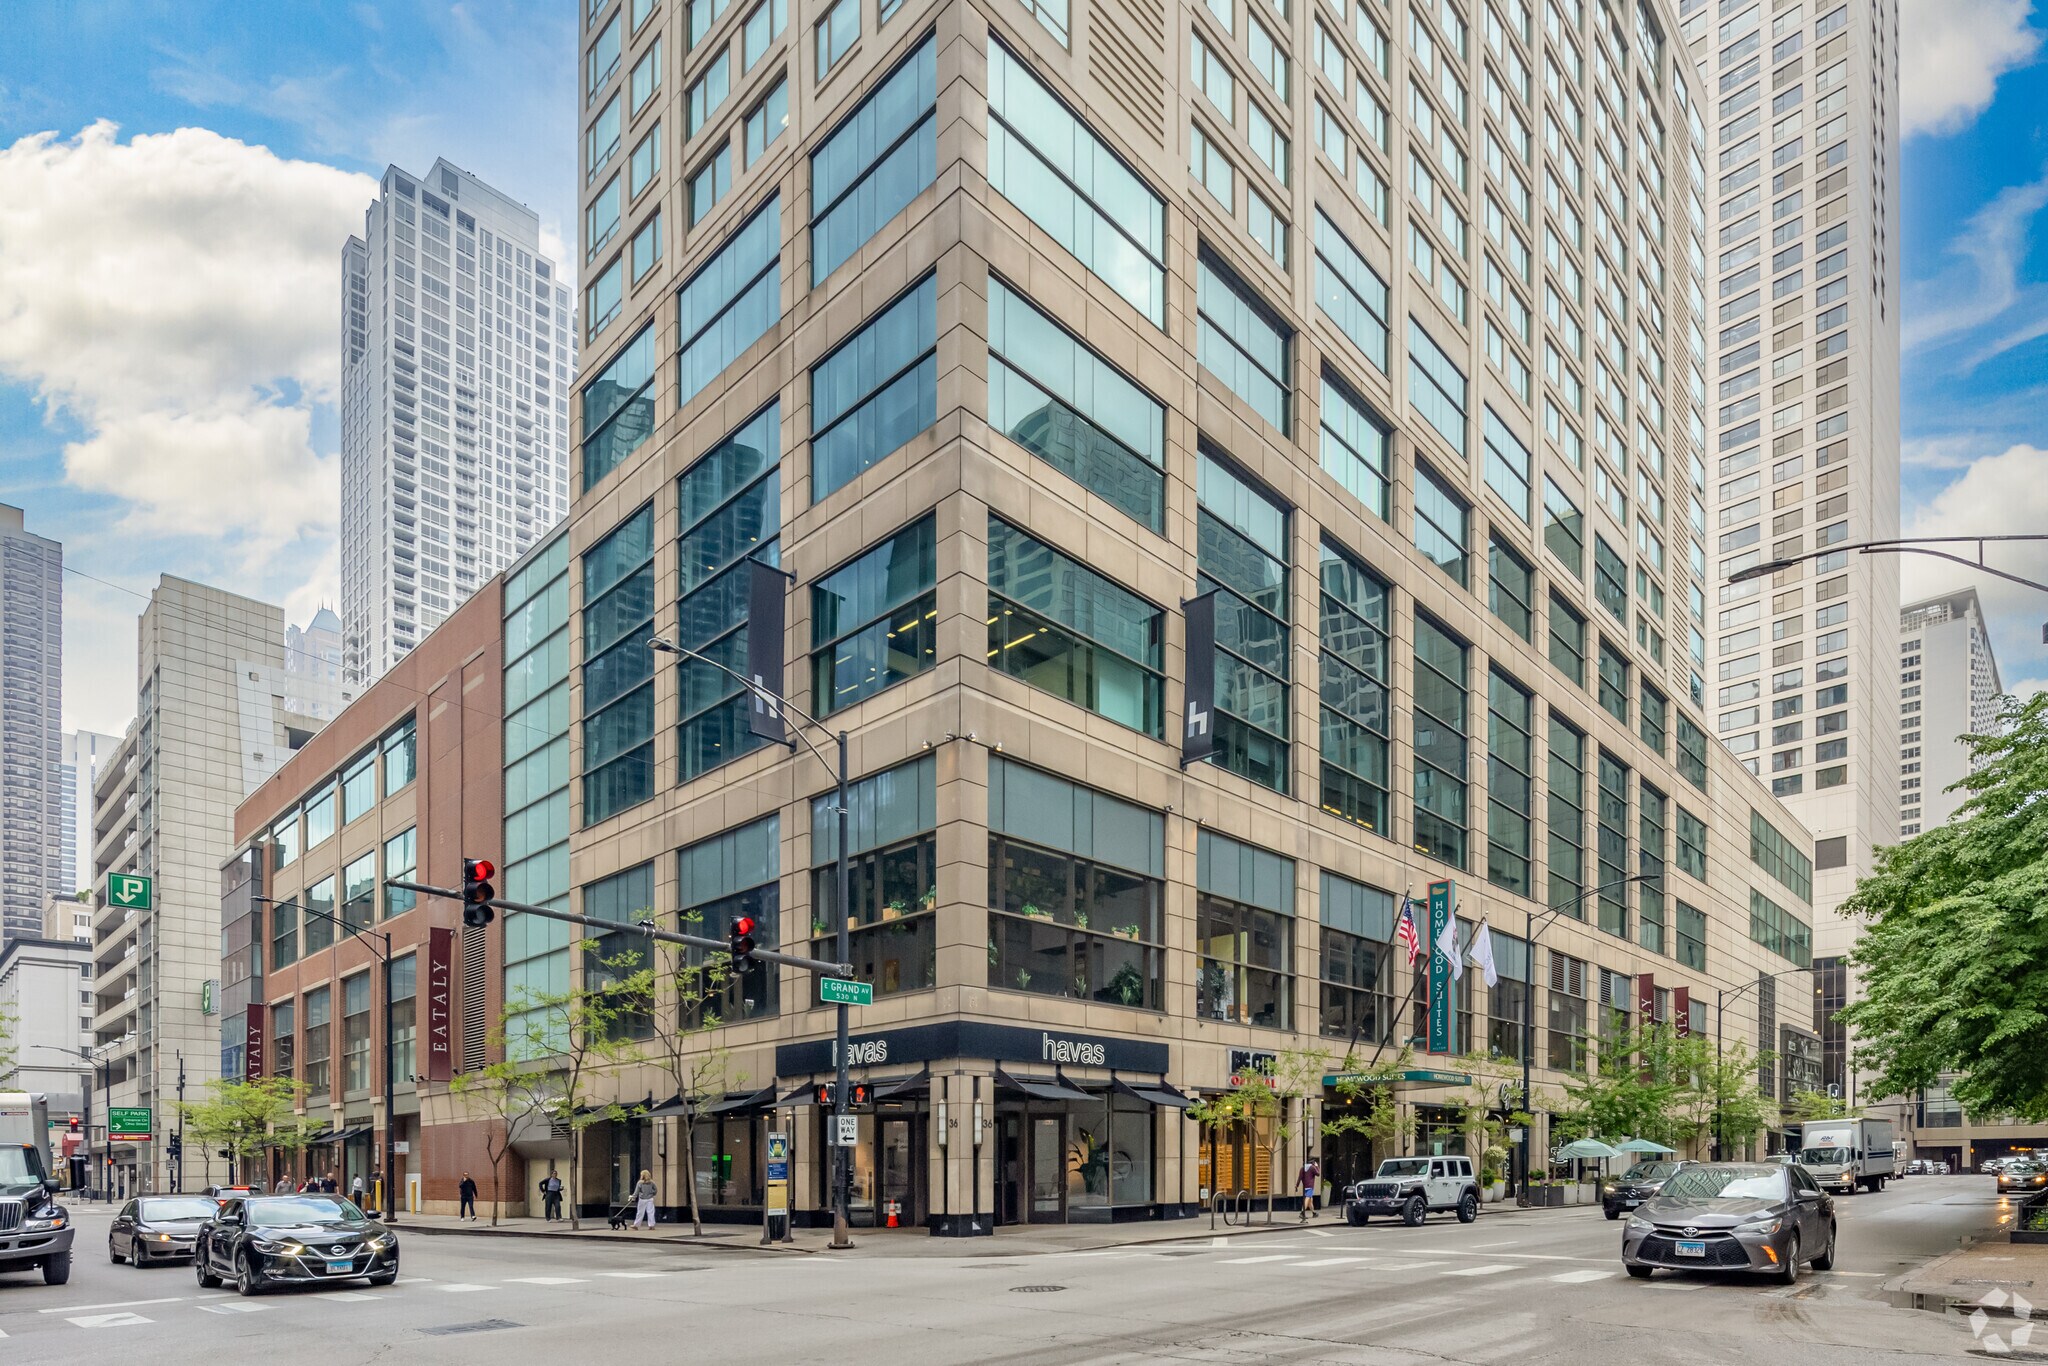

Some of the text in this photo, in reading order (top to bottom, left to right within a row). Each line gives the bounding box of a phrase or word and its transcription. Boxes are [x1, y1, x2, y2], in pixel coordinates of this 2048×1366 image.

[1435, 901, 1444, 974] HOMEOOD
[831, 982, 860, 994] GRAND
[433, 960, 447, 1052] EATALY
[1043, 1032, 1105, 1065] havas
[1383, 1072, 1406, 1081] SUIES
[841, 1118, 855, 1126] ONE
[949, 1118, 958, 1128] 36
[982, 1119, 993, 1129] 36
[840, 1126, 856, 1134] WAY
